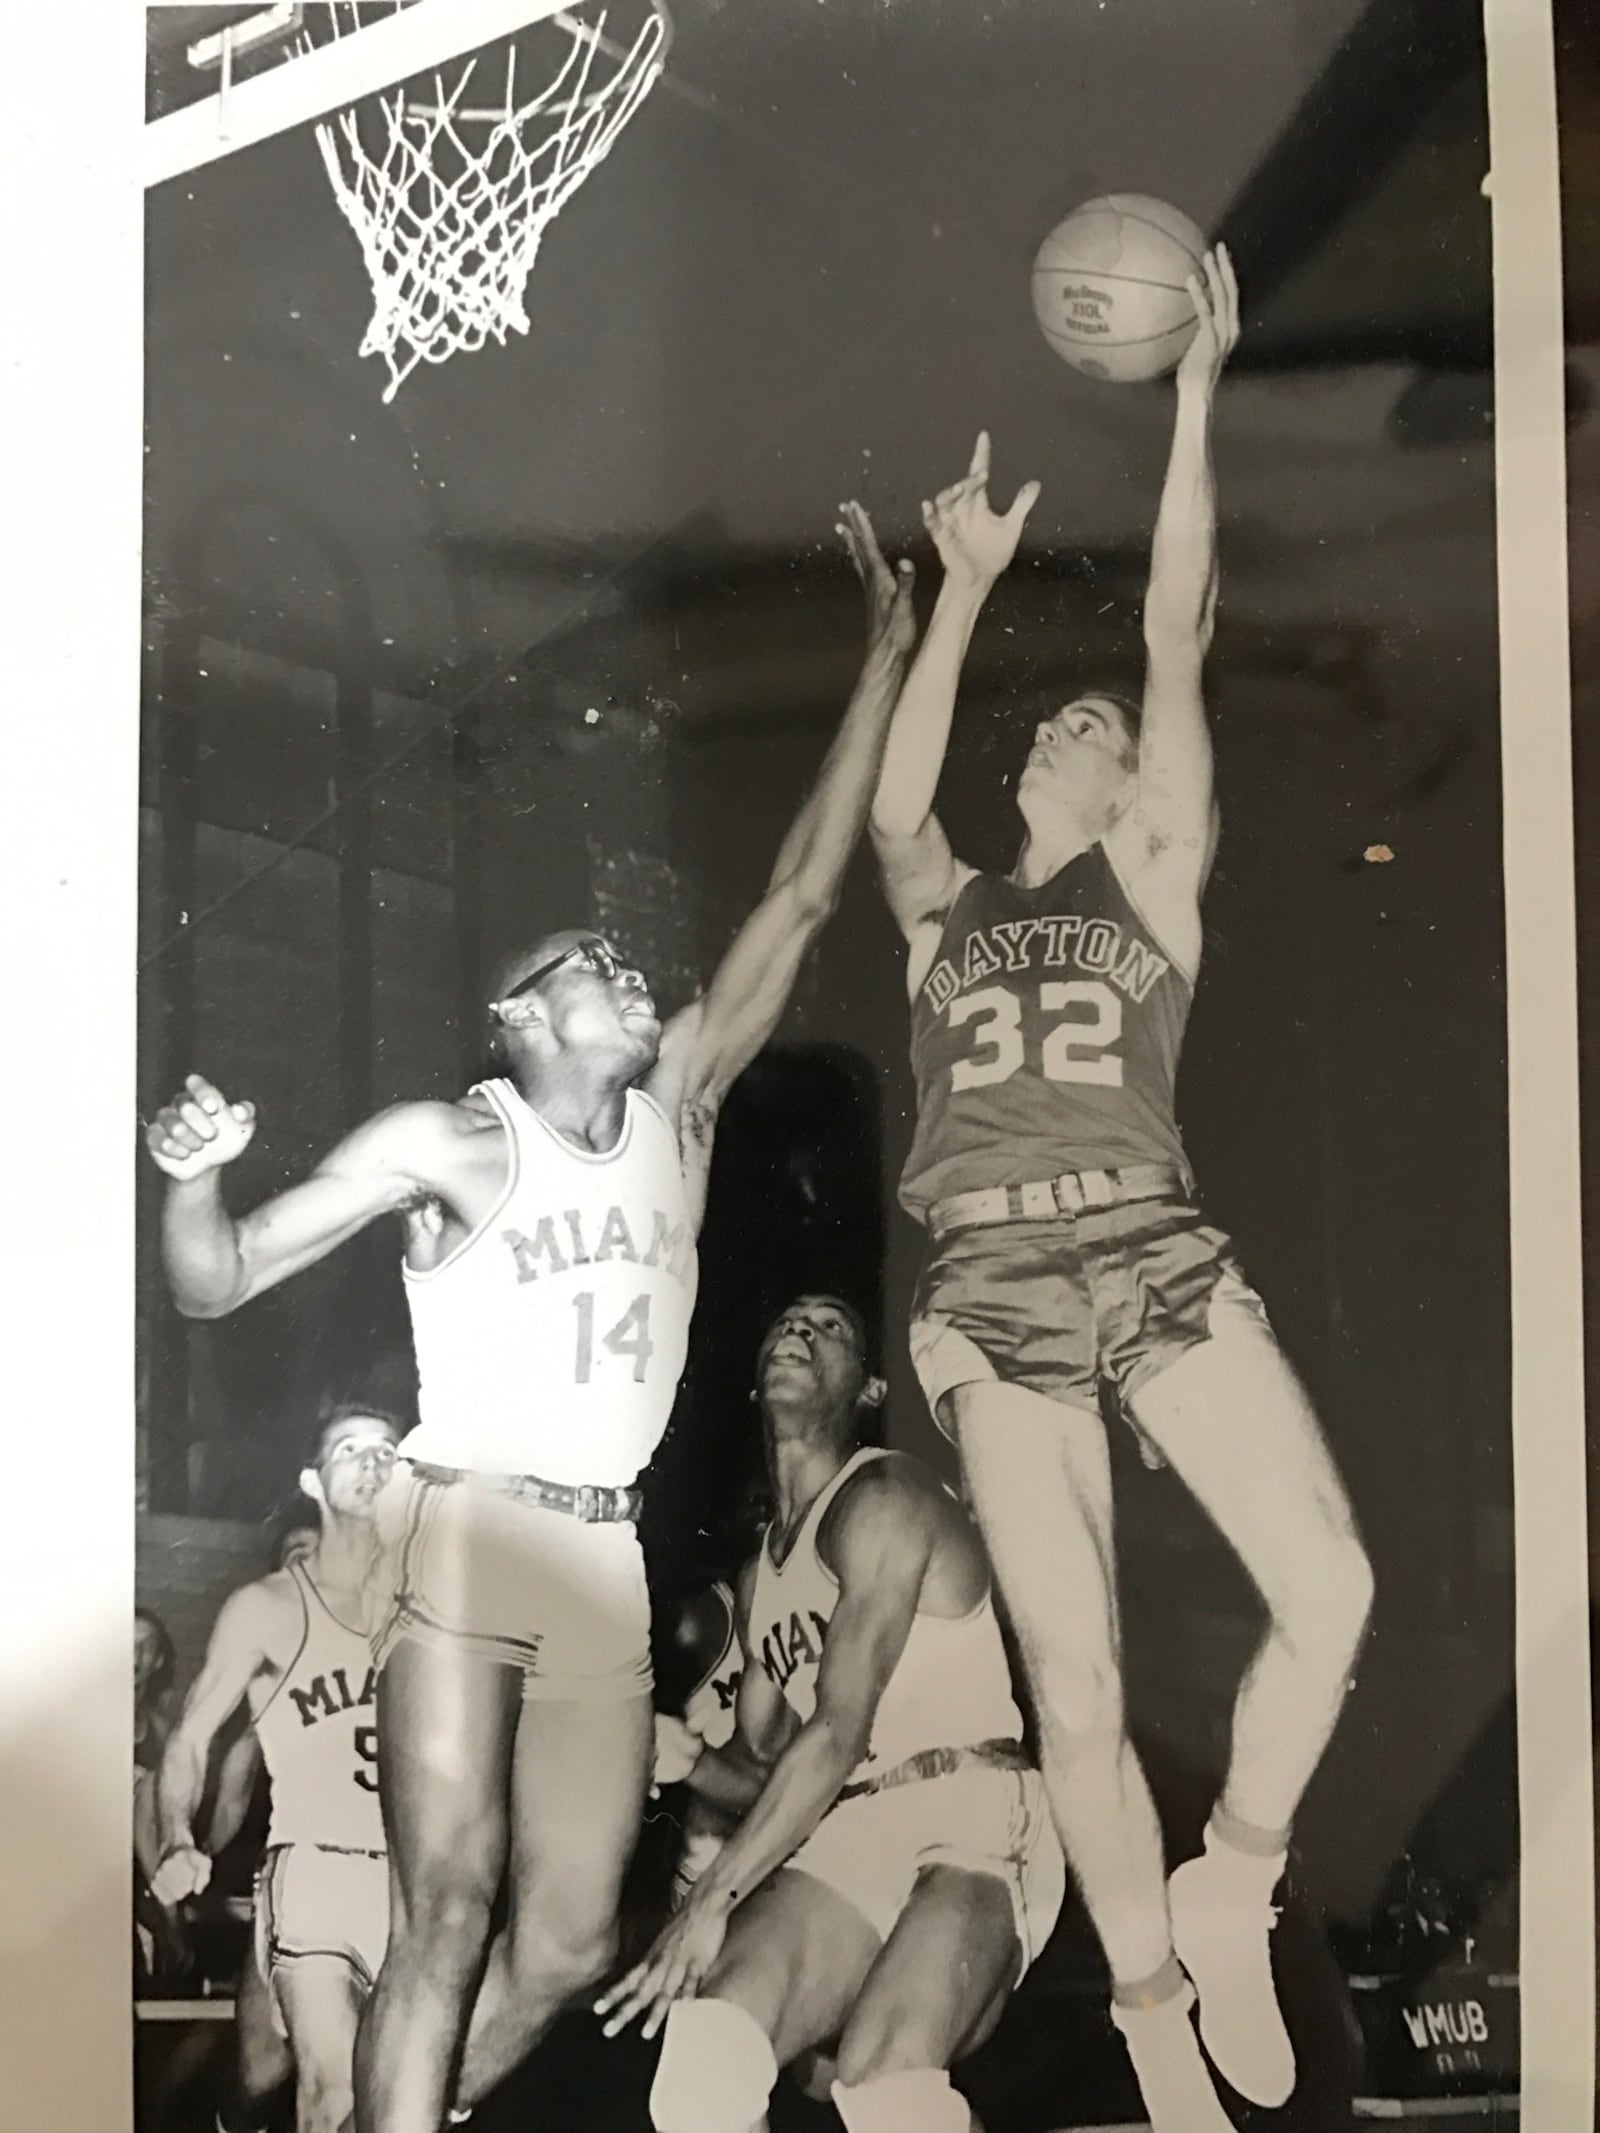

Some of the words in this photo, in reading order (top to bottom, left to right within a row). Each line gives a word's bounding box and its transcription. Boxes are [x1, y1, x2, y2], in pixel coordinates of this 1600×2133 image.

[924, 916, 1169, 1015] DAYTON
[948, 981, 1123, 1093] 32
[572, 1292, 654, 1383] 14
[1402, 2001, 1488, 2048] WMUB
